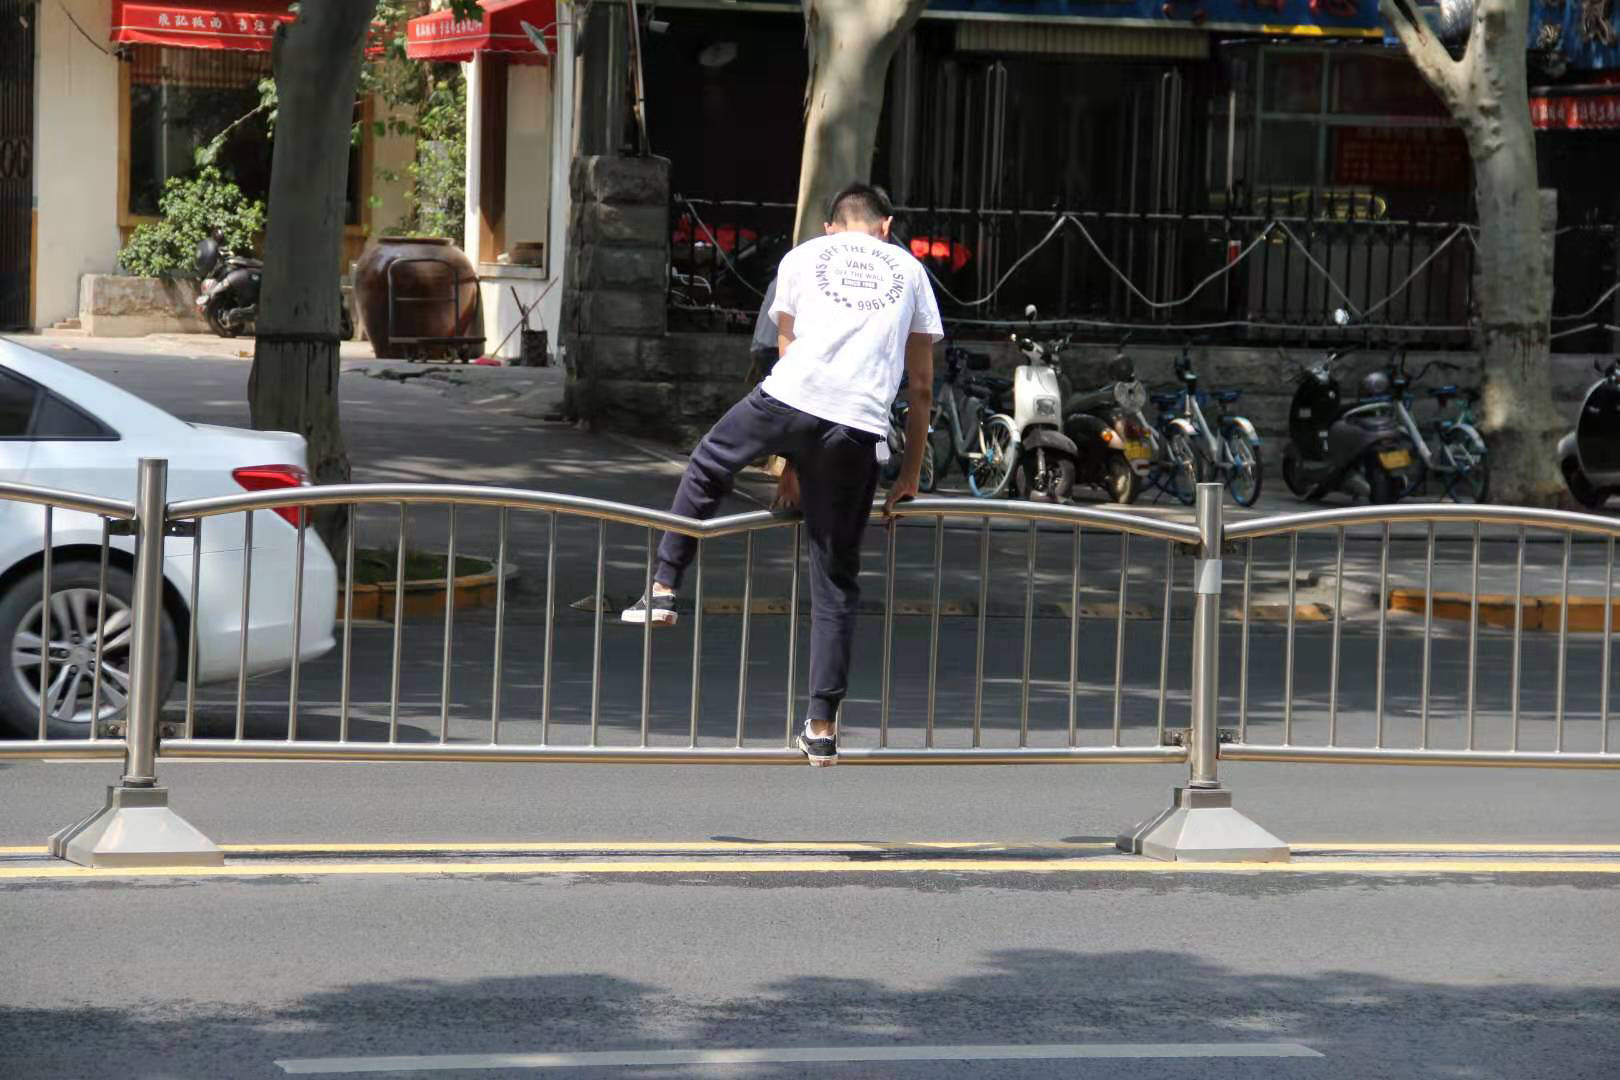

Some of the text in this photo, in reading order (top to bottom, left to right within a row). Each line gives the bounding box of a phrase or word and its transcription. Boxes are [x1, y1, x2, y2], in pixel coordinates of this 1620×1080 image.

[819, 246, 839, 262] OFF
[841, 244, 866, 253] THE
[845, 259, 875, 271] VANS
[871, 248, 900, 271] WALL
[816, 264, 830, 291] VANS
[865, 273, 885, 282] WALL
[884, 273, 904, 304] SINCE
[857, 298, 885, 311] 1966
